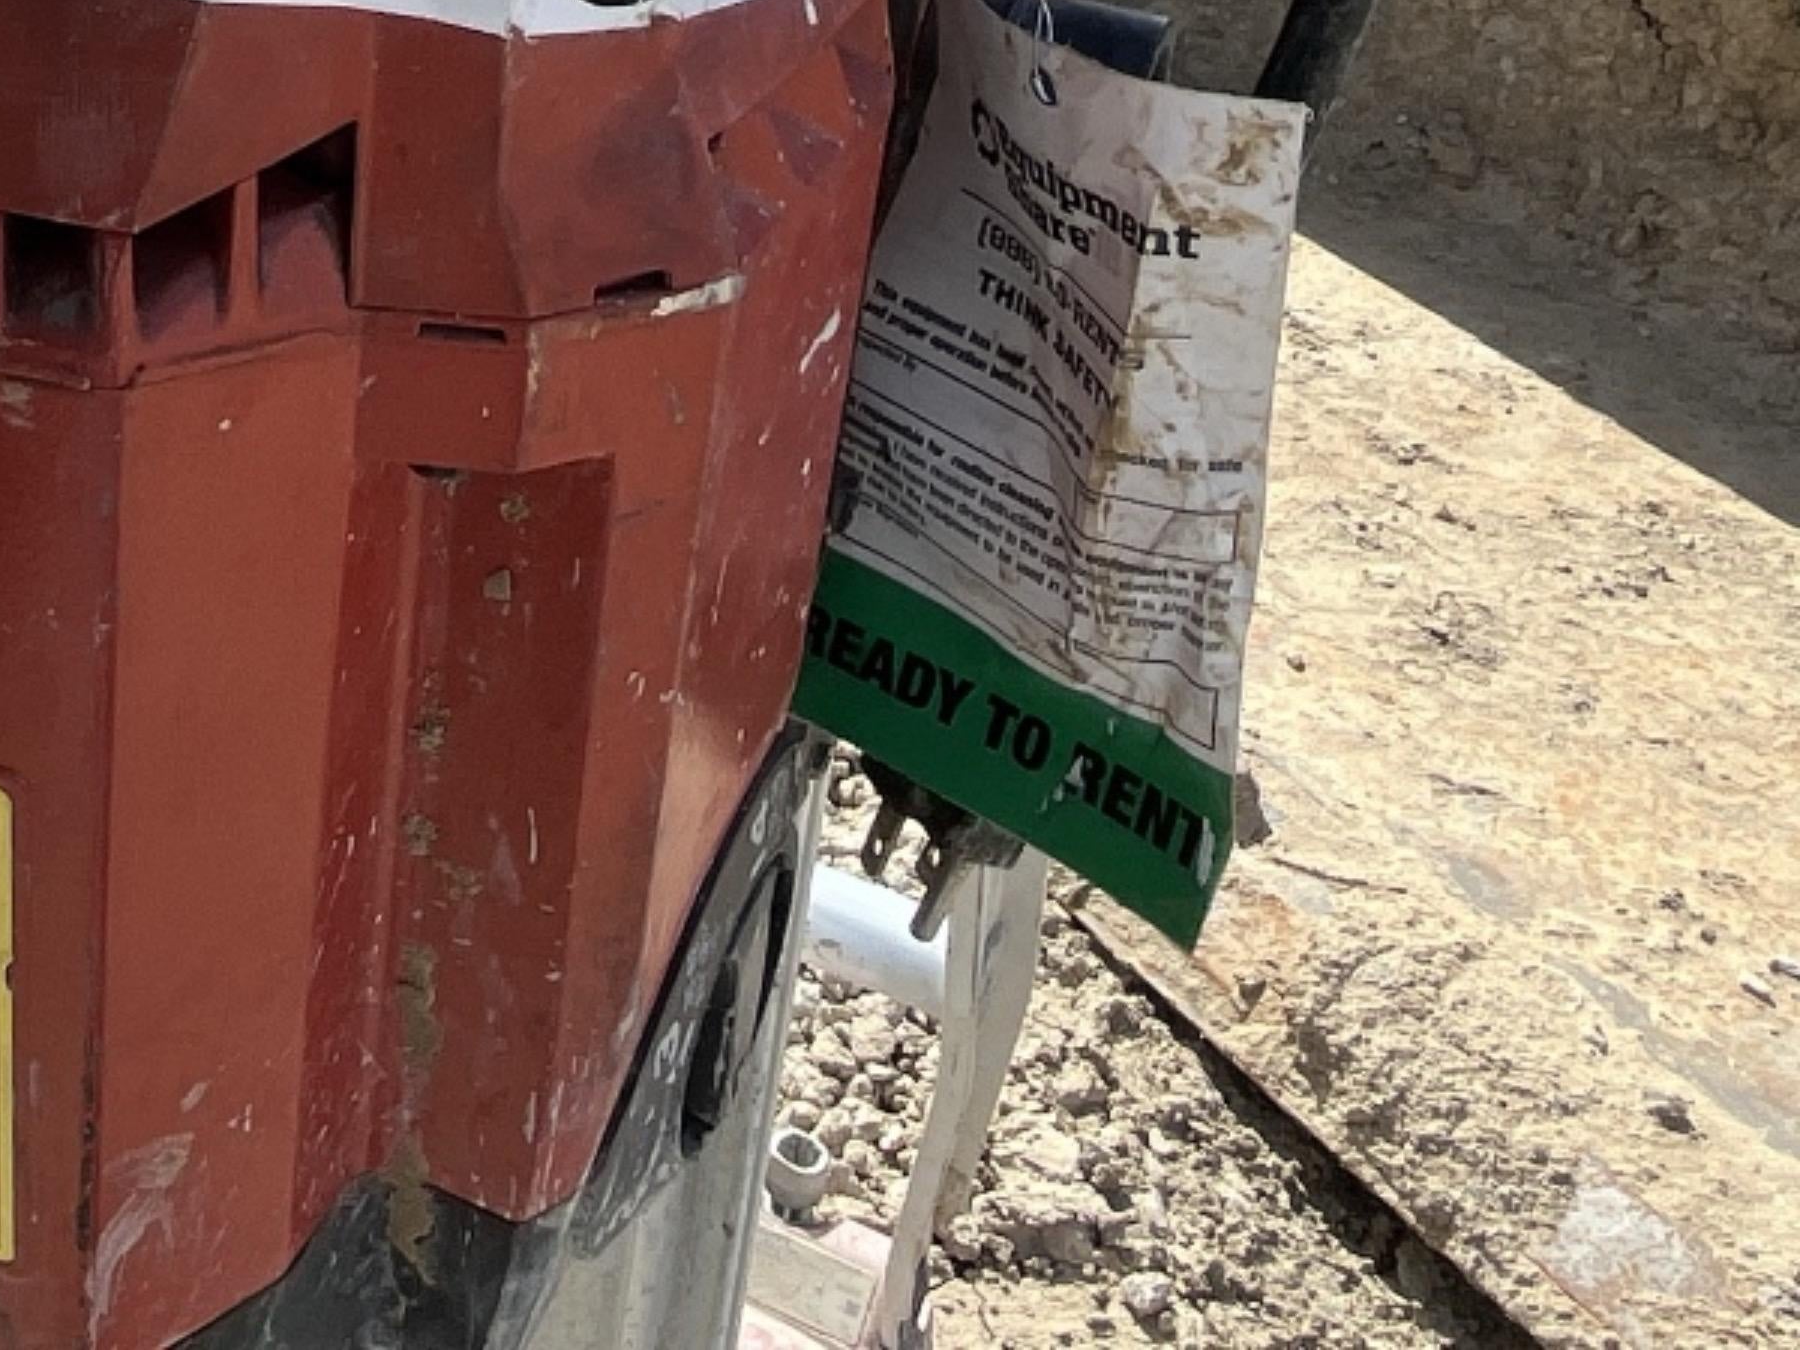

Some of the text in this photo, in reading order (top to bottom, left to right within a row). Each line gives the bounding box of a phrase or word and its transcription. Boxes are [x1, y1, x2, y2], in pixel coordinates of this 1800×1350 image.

[805, 606, 1210, 871] READY TO RENT
